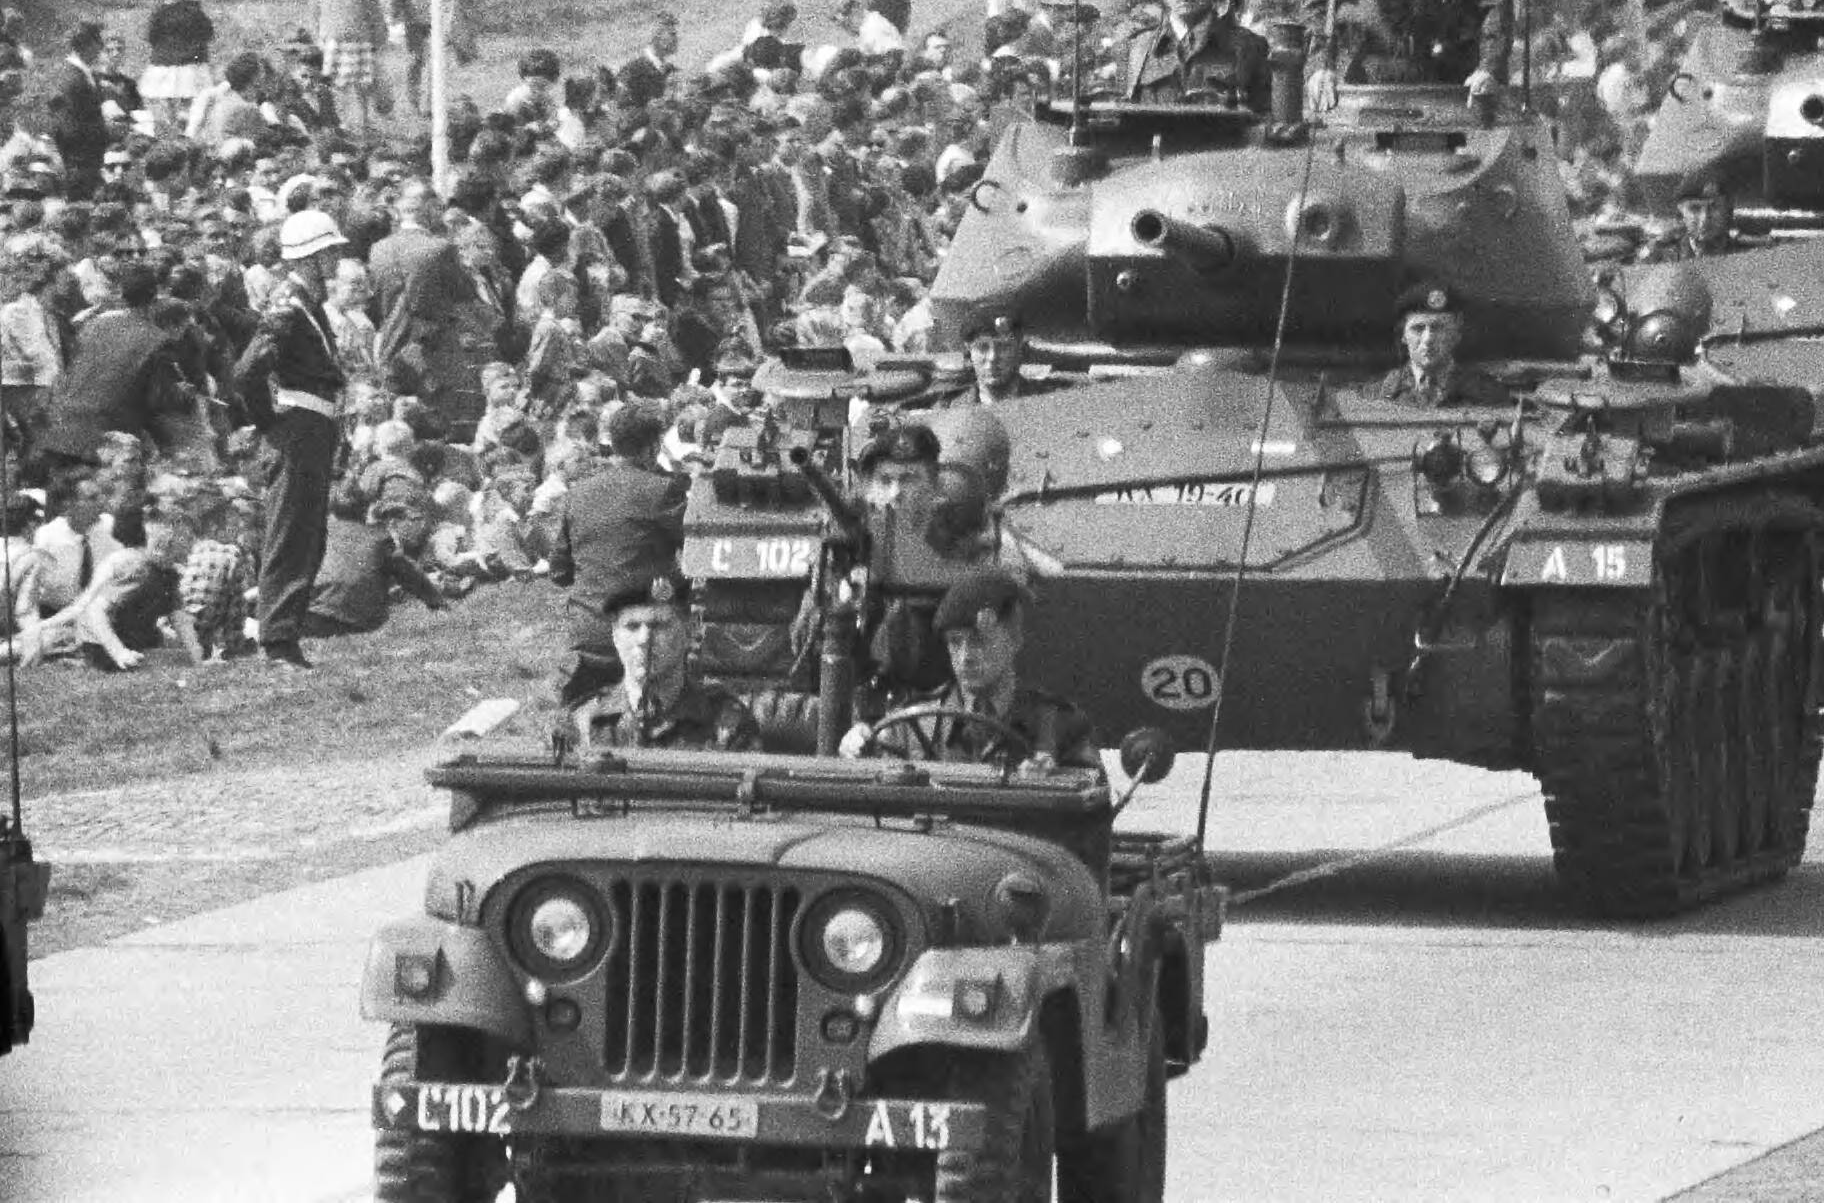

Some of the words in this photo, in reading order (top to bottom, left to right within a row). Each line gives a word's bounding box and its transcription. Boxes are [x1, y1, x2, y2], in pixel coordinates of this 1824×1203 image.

[711, 540, 733, 572] C
[756, 539, 811, 573] 102
[1541, 546, 1567, 580] A
[1591, 544, 1627, 580] 15
[1151, 668, 1212, 698] 20
[417, 1084, 512, 1134] C102
[865, 1099, 896, 1147] A
[909, 1101, 951, 1149] 13
